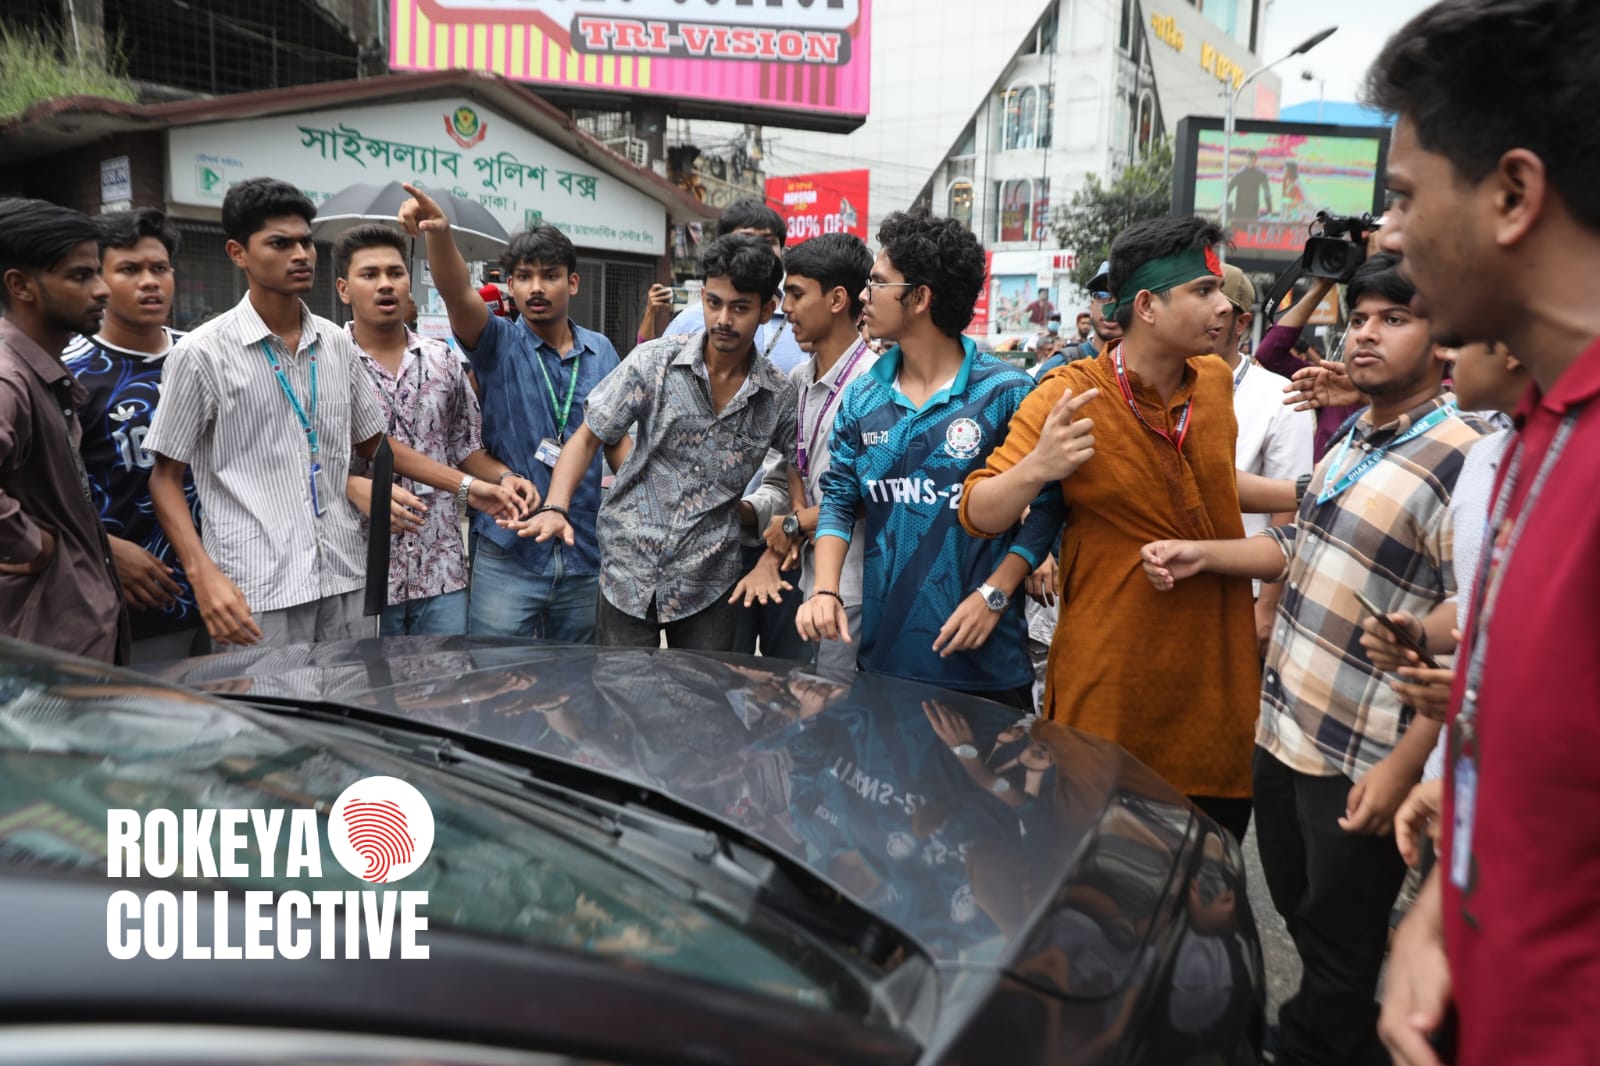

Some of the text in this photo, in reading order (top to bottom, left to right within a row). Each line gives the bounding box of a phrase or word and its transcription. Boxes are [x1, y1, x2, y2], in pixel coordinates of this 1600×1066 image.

[578, 17, 841, 62] TRI-VISION
[297, 123, 600, 202] সাইন্সল্যাব পুলিশ বক্স
[787, 214, 820, 238] 30%
[1347, 455, 1375, 481] DHAKA
